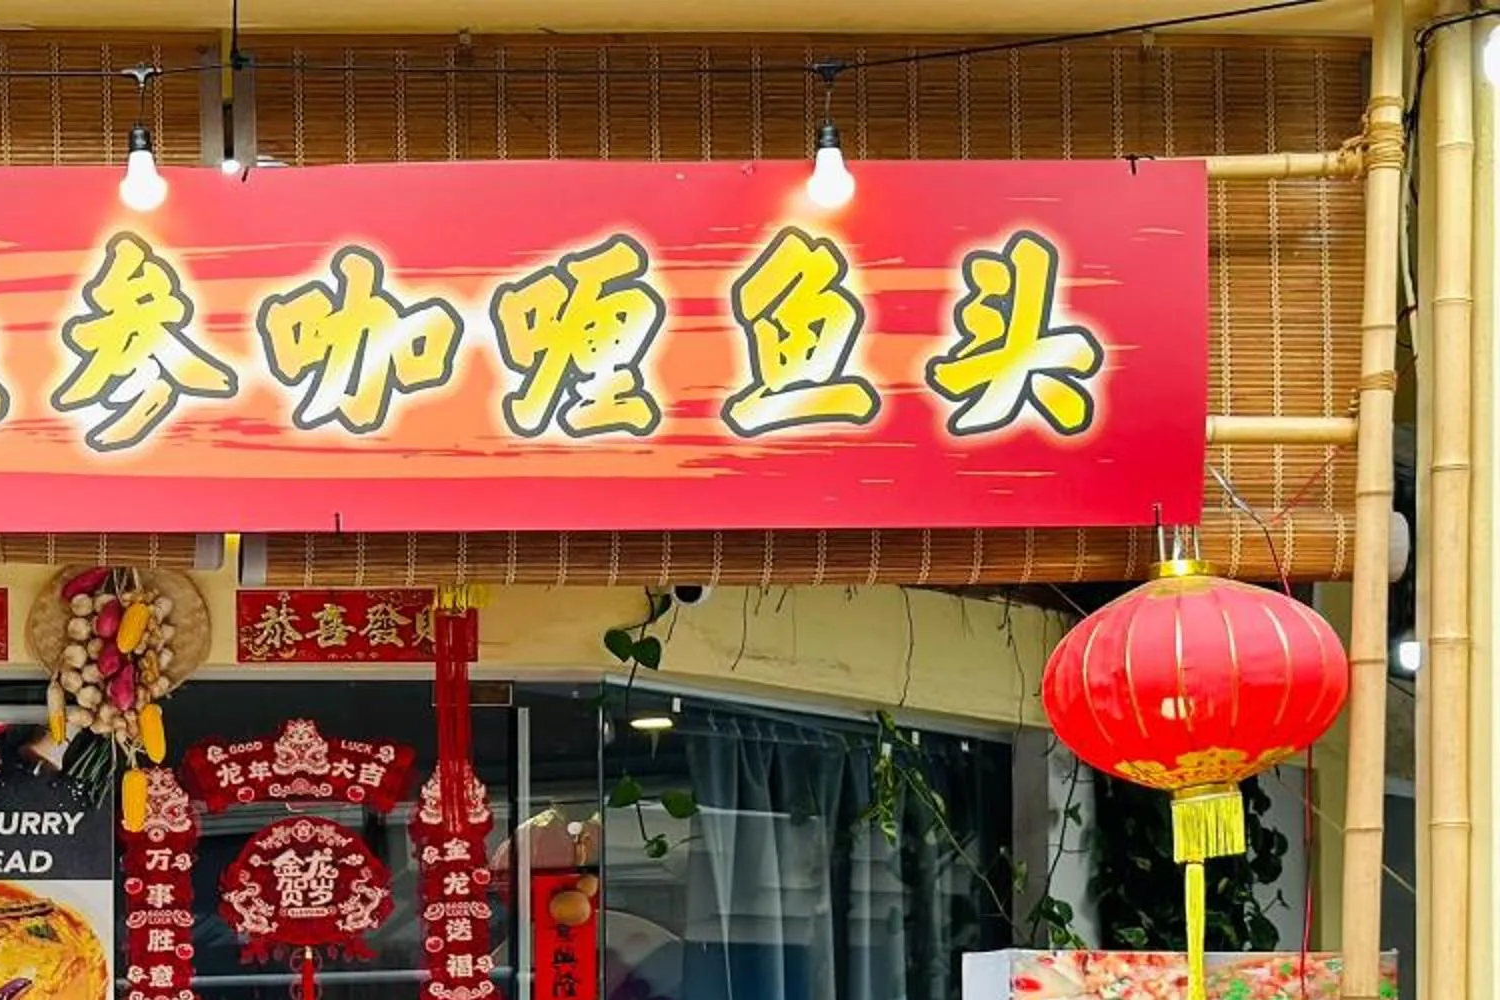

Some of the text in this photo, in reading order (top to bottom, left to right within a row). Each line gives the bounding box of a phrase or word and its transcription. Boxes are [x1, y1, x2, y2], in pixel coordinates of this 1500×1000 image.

[229, 739, 373, 755] GOOD LUCK
[145, 848, 175, 988] 万事胜意
